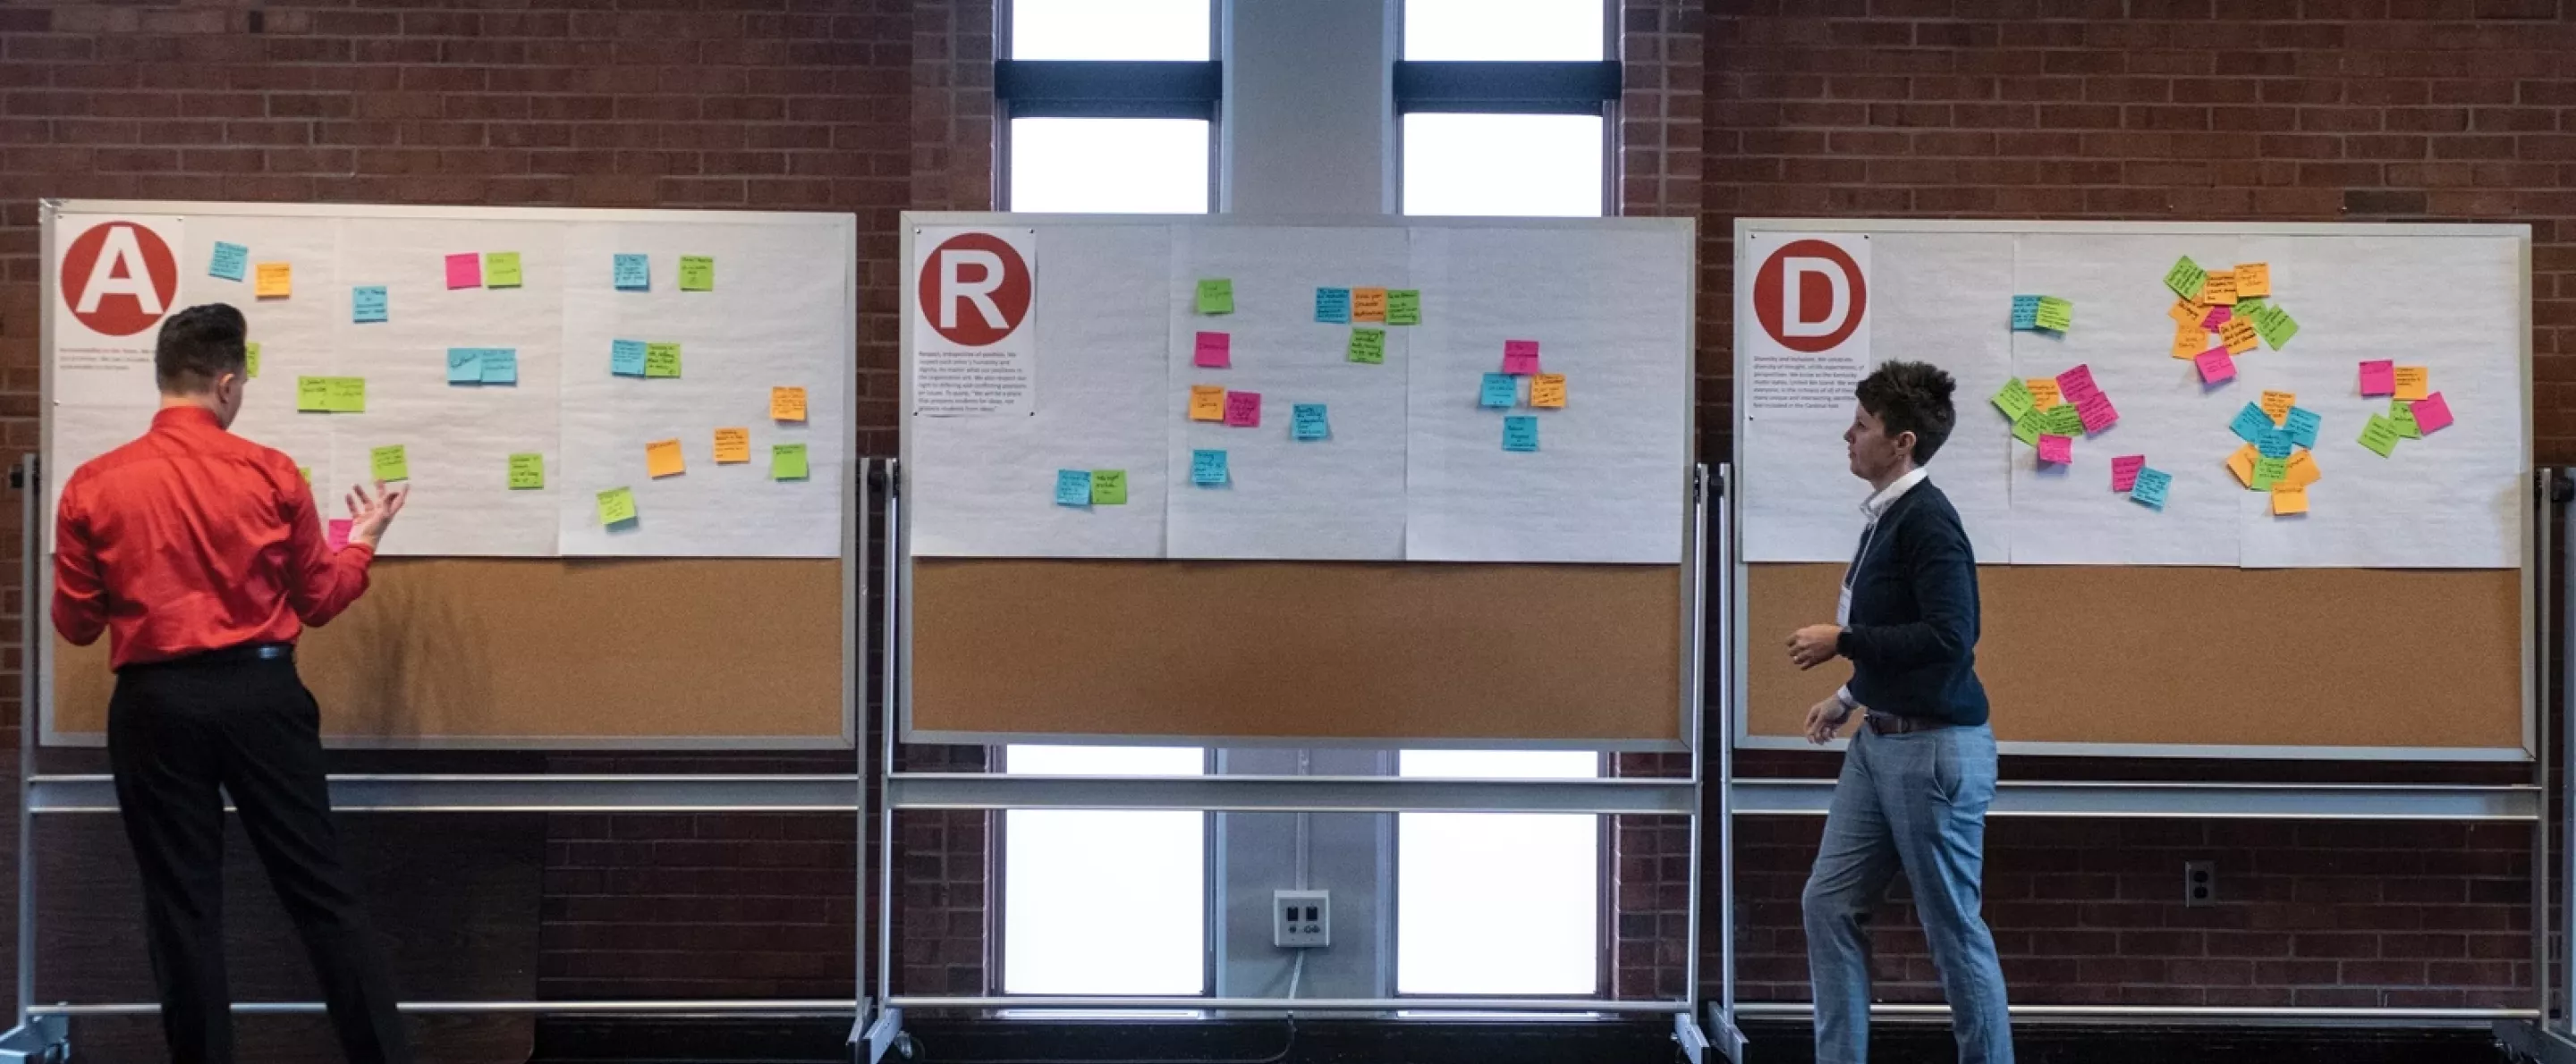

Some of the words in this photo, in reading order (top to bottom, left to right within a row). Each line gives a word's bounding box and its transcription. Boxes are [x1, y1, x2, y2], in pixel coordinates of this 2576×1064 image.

[76, 227, 164, 314] A
[941, 249, 1009, 329] R
[1783, 257, 1851, 337] D
